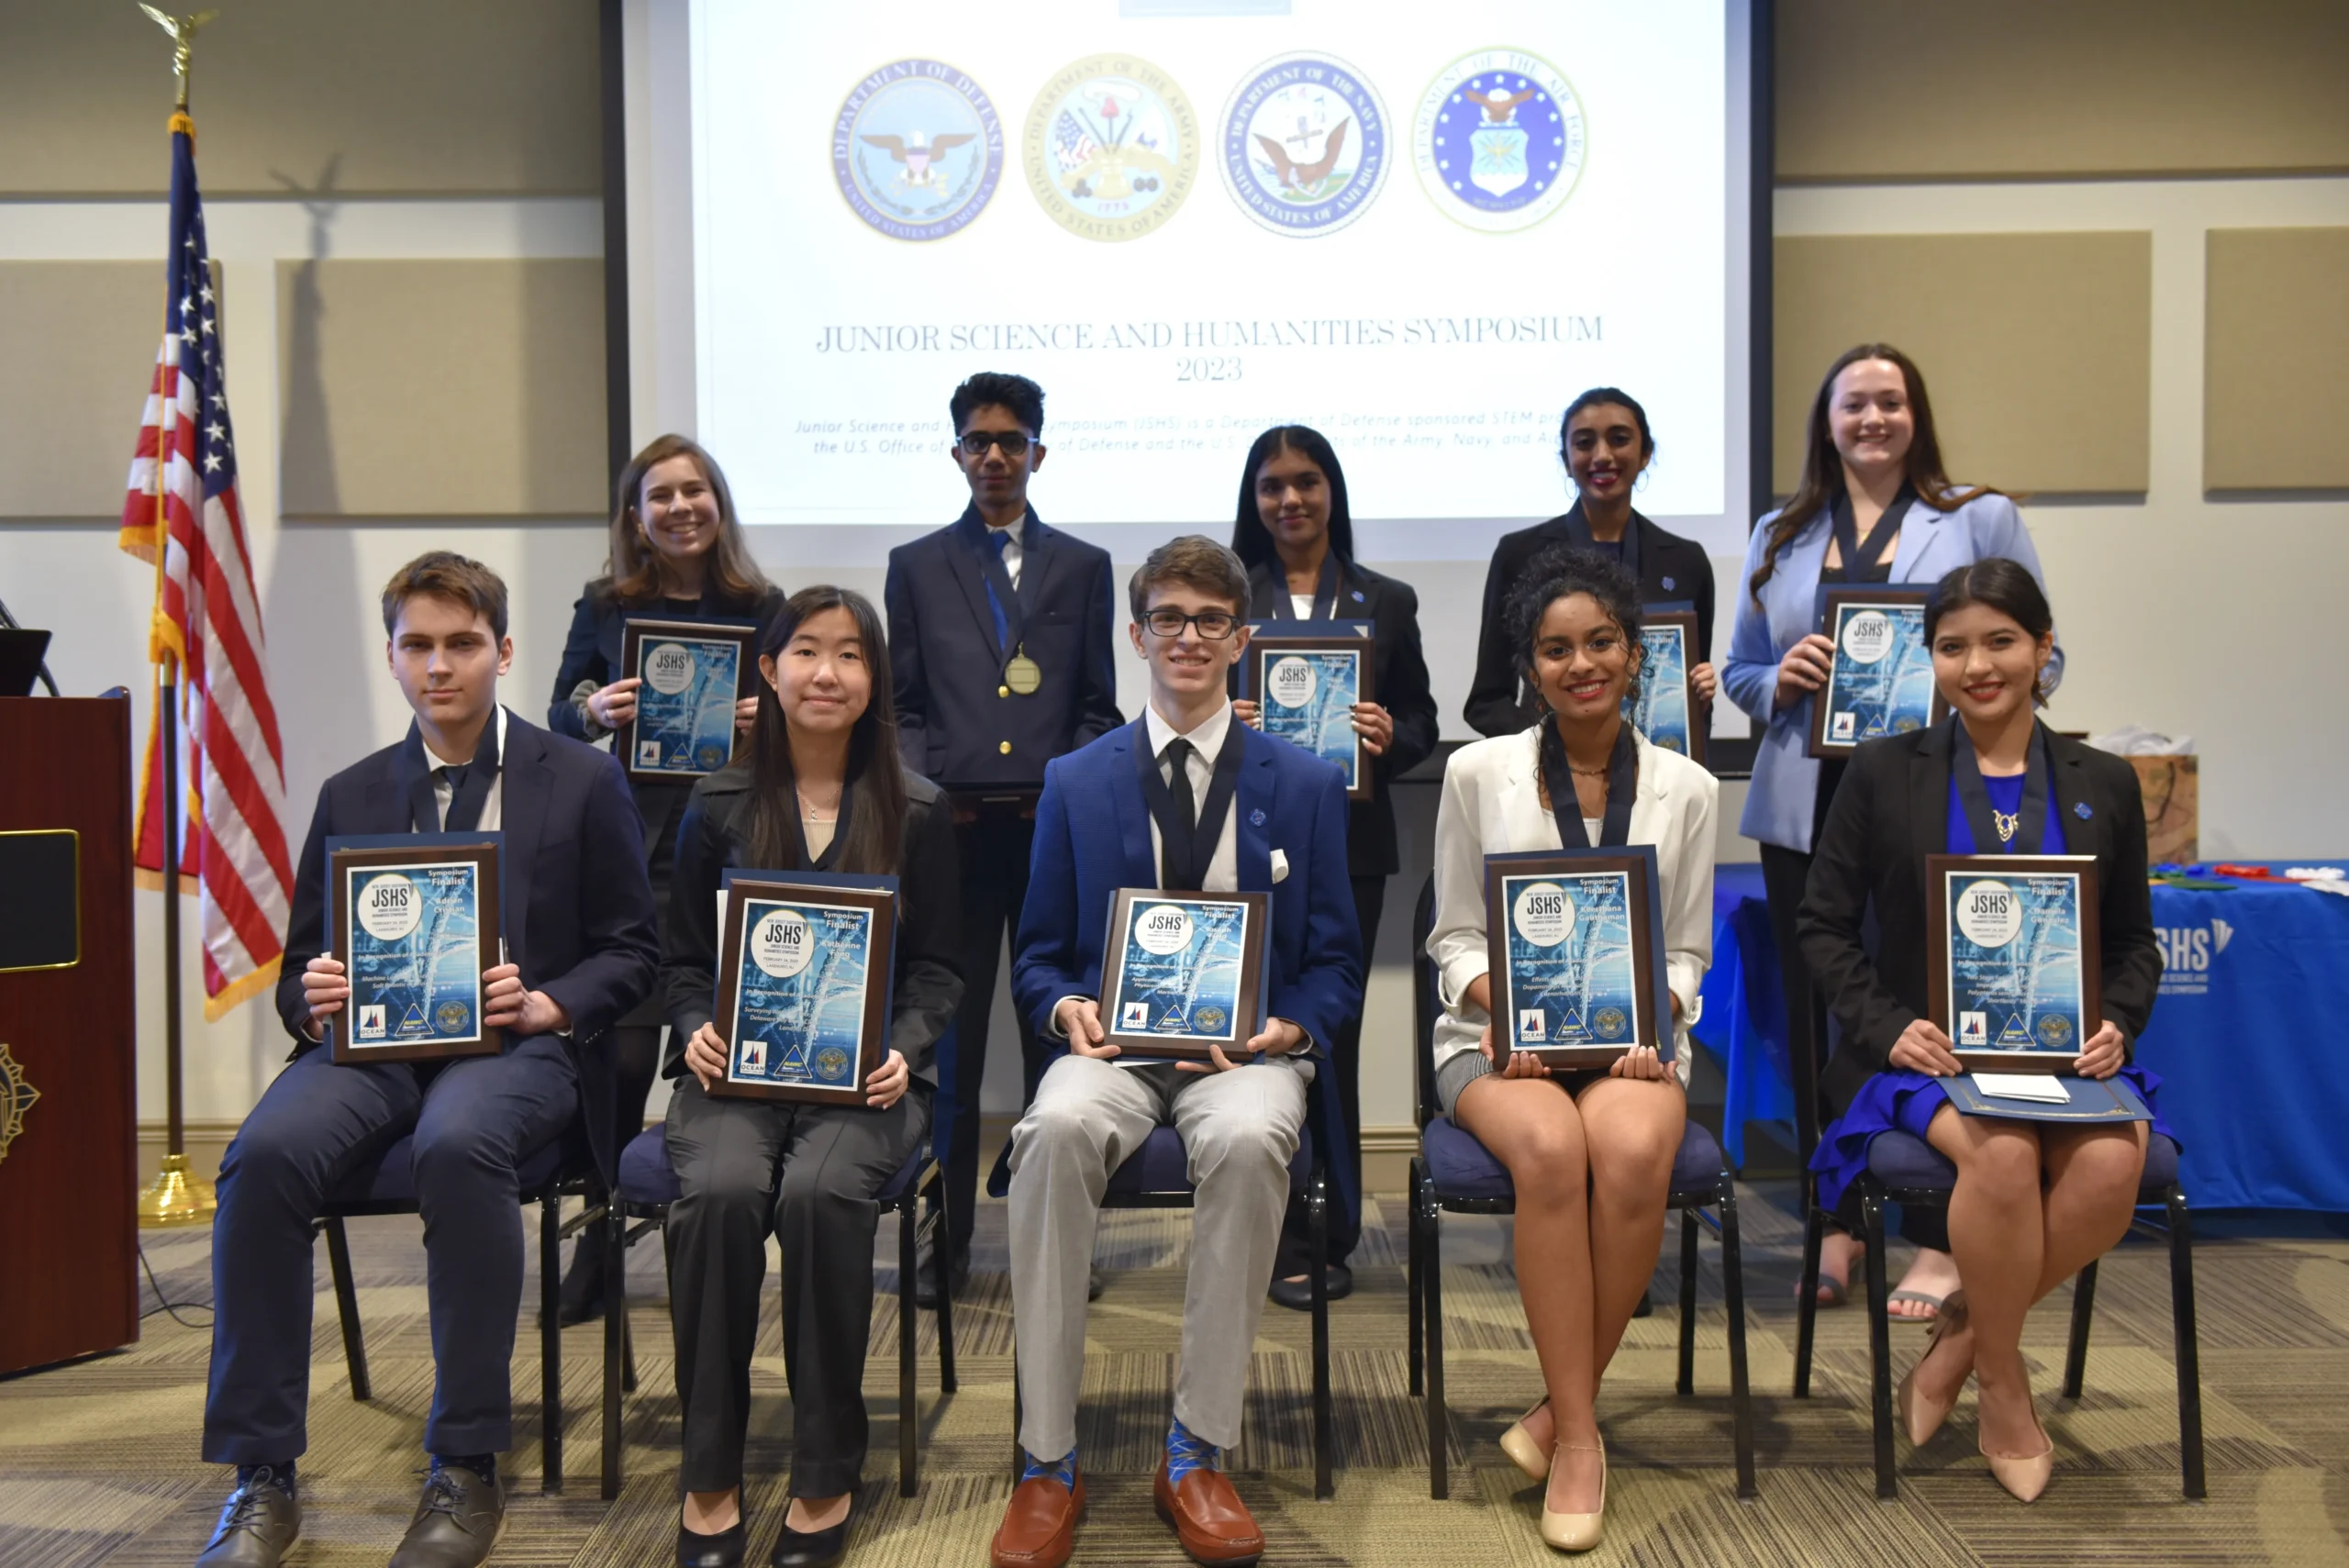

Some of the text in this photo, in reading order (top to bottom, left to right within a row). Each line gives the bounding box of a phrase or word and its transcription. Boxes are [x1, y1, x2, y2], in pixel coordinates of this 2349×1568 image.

[1509, 53, 1536, 73] THE
[1550, 79, 1570, 103] AIR
[1030, 61, 1192, 139] DEPARTMENT OF THE ARMY
[1230, 68, 1377, 137] DEPARTMENT OF THE NAVY
[834, 61, 1002, 159] DEPARTMENT OF DEFENSE
[1030, 152, 1193, 236] UNITED STATES OF AMERICA
[1230, 154, 1376, 223] UNITED STATES OF AMERICA
[817, 316, 1604, 353] JUNIOR SCIENCE AND HUMANITIES SYMPOSIUM
[1176, 356, 1242, 382] 2023
[796, 419, 843, 434] Junior
[849, 418, 906, 434] Science
[911, 419, 940, 433] and
[1042, 419, 1128, 436] ymposium
[1133, 416, 1181, 432] (JSHS)
[1187, 417, 1199, 429] is
[1205, 418, 1215, 429] a
[1319, 413, 1335, 427] of
[1340, 412, 1400, 427] Defense
[1407, 413, 1486, 428] sponsored
[1492, 410, 1533, 426] STEM
[813, 440, 839, 455] the
[877, 439, 923, 457] Office
[930, 439, 945, 457] of
[1058, 438, 1074, 455] of
[1079, 437, 1139, 452] Defense
[1145, 438, 1174, 451] and
[1181, 438, 1205, 450] the
[1351, 434, 1367, 450] of
[1373, 433, 1397, 448] the
[1502, 433, 1531, 446] and
[1854, 621, 1884, 638] JSHS
[656, 653, 685, 670] JSHS
[1279, 667, 1307, 683] JSHS
[428, 869, 469, 877] Symposium
[431, 877, 466, 886] Finalist
[1580, 878, 1619, 886] Symposium
[372, 888, 408, 908] JSHS
[1584, 886, 1617, 895] Finalist
[2032, 886, 2067, 895] Finalist
[1527, 895, 1562, 915] JSHS
[1971, 895, 2008, 914] JSHS
[824, 911, 863, 920] Symposium
[1149, 916, 1182, 930] JSHS
[826, 920, 859, 930] Finalist
[765, 924, 802, 945] JSHS
[2153, 927, 2210, 972] SHS
[743, 1006, 772, 1015] Surveying
